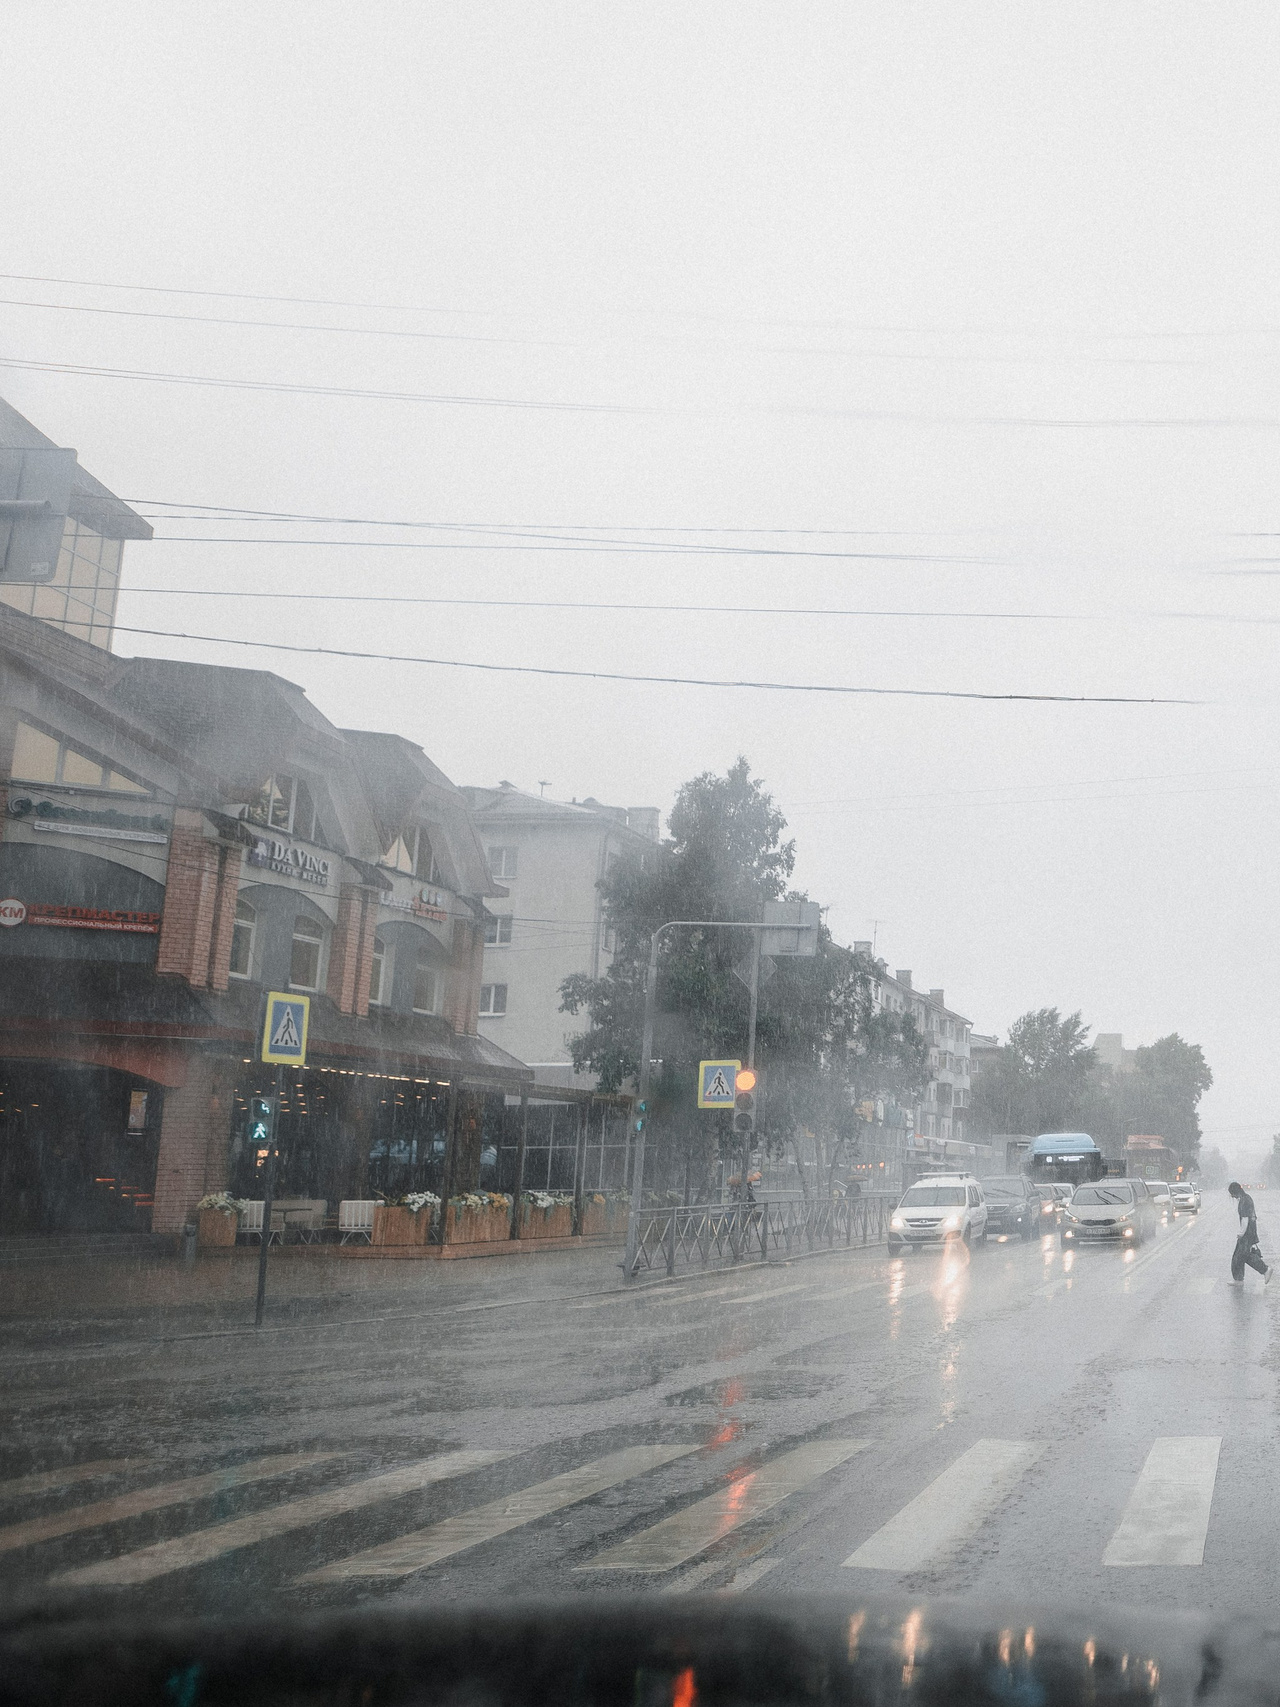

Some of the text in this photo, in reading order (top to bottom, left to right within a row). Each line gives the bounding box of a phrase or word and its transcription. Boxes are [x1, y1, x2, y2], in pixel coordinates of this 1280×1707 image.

[273, 841, 331, 876] DA VINCI
[28, 904, 160, 923] КРЕПМАСТЕР
[34, 917, 122, 930] ПРОФЕССИОНАЛЬНЫЙ
